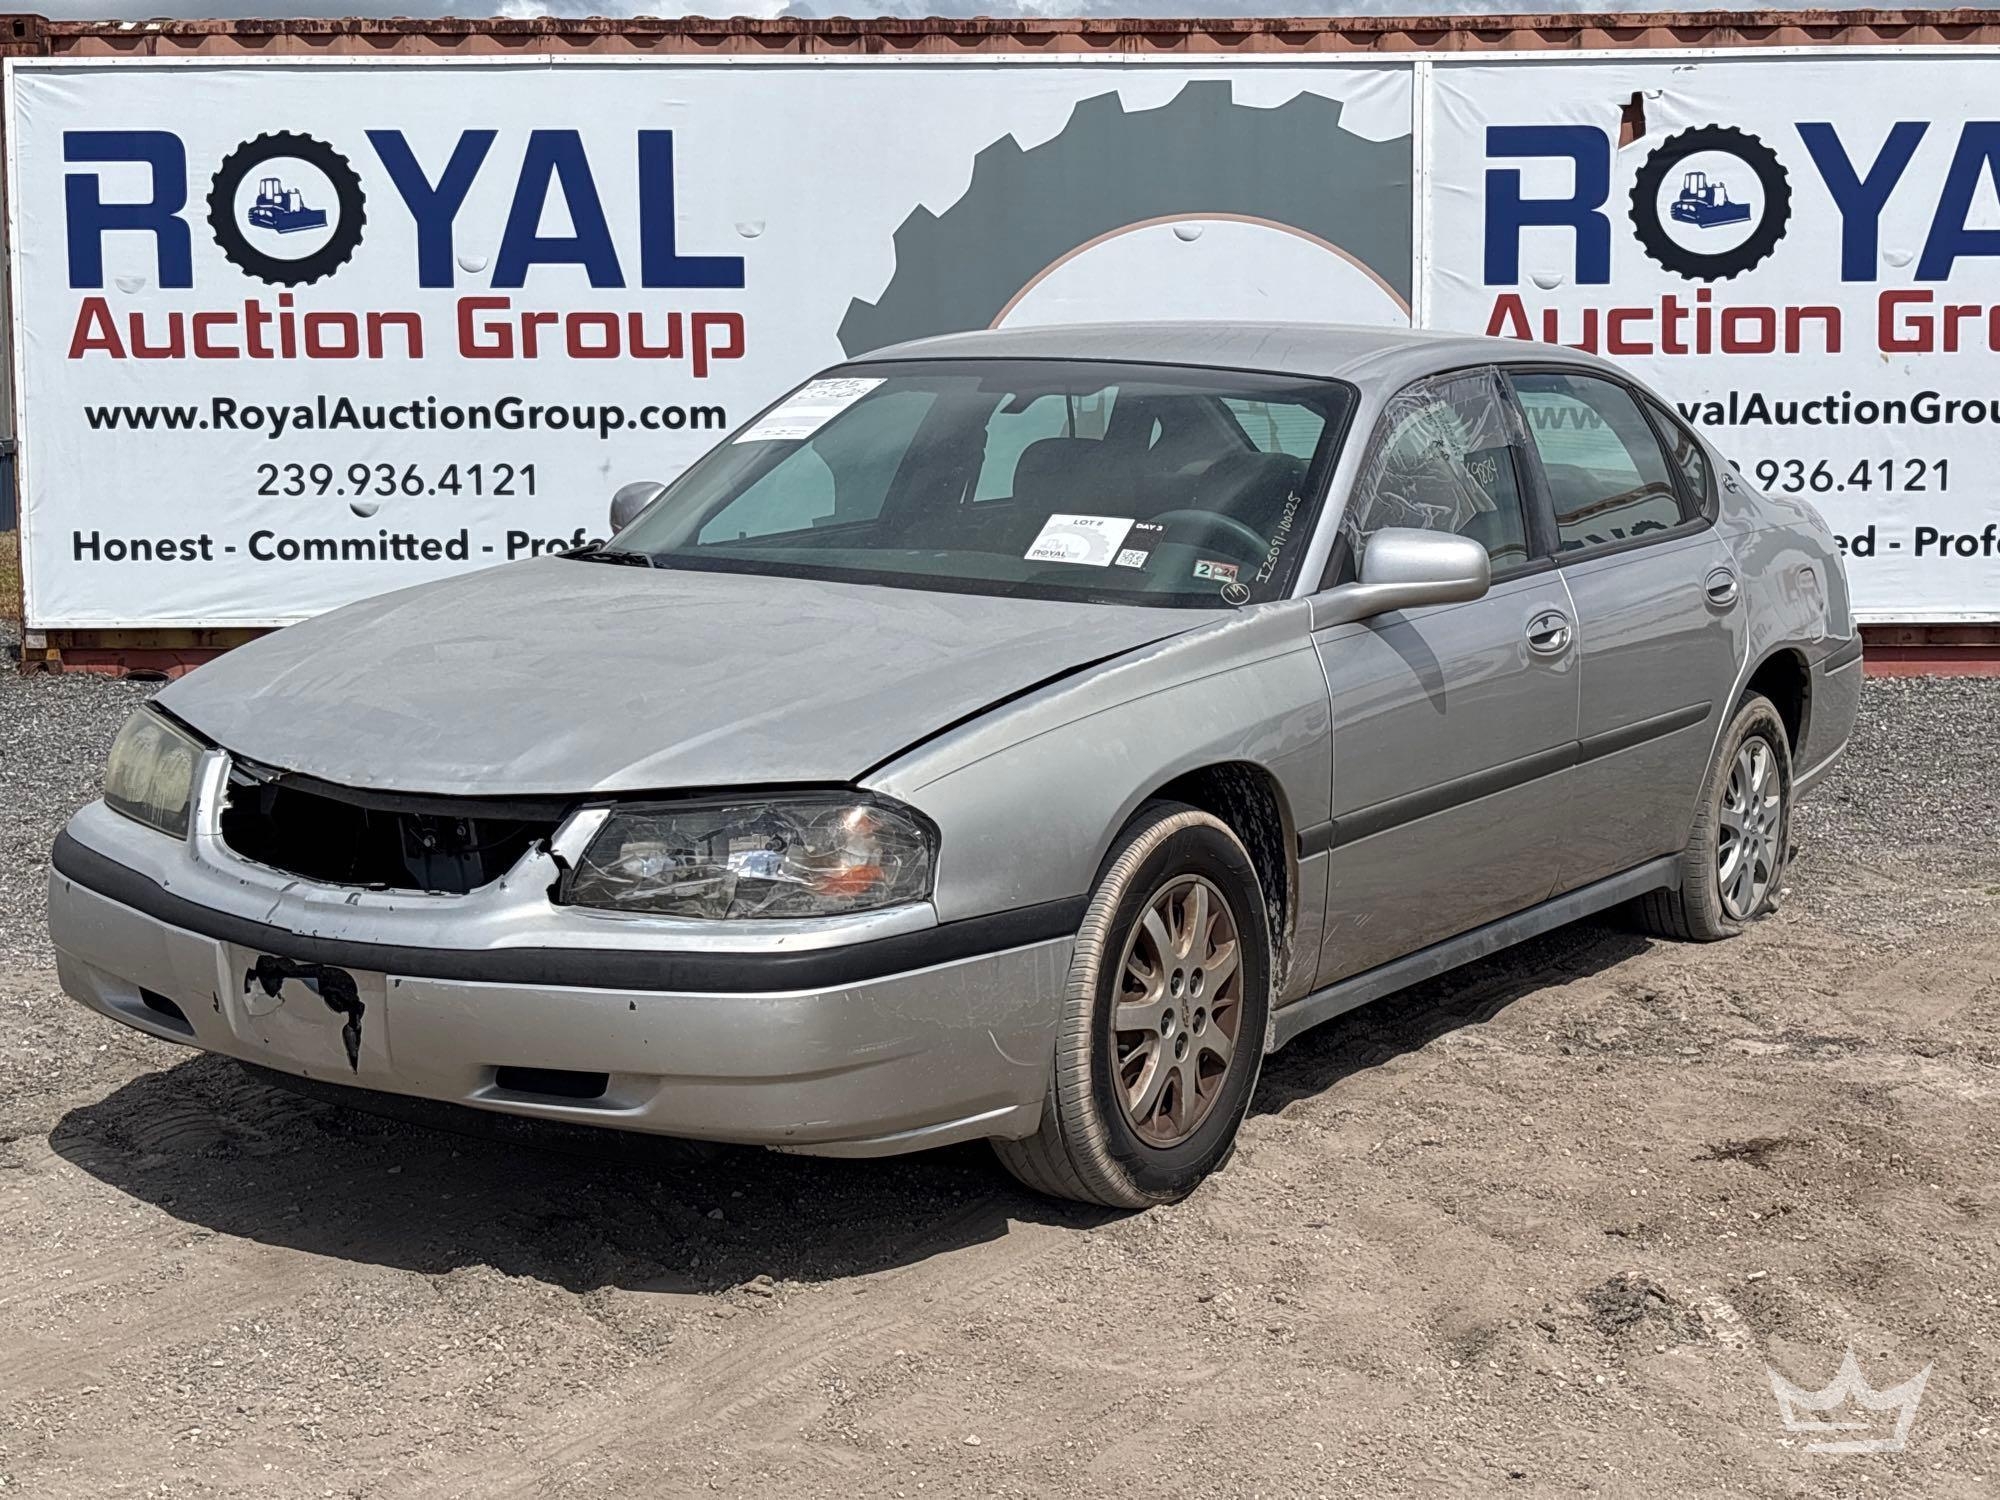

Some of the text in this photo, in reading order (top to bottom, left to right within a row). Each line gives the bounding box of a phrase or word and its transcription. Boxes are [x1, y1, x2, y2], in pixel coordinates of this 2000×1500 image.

[64, 129, 745, 288] ROYAL
[68, 293, 746, 378] Auction Group
[1484, 287, 2000, 355] Auction Gr
[85, 396, 727, 439] www.RoyalAuctionGroup.com
[257, 463, 537, 497] 239.936.4121
[1135, 522, 1156, 531] DAY
[1914, 522, 2000, 558] Prof
[73, 530, 213, 562] Honest
[248, 529, 469, 562] Committed
[1032, 549, 1067, 557] ROYAL
[1199, 564, 1210, 575] 2
